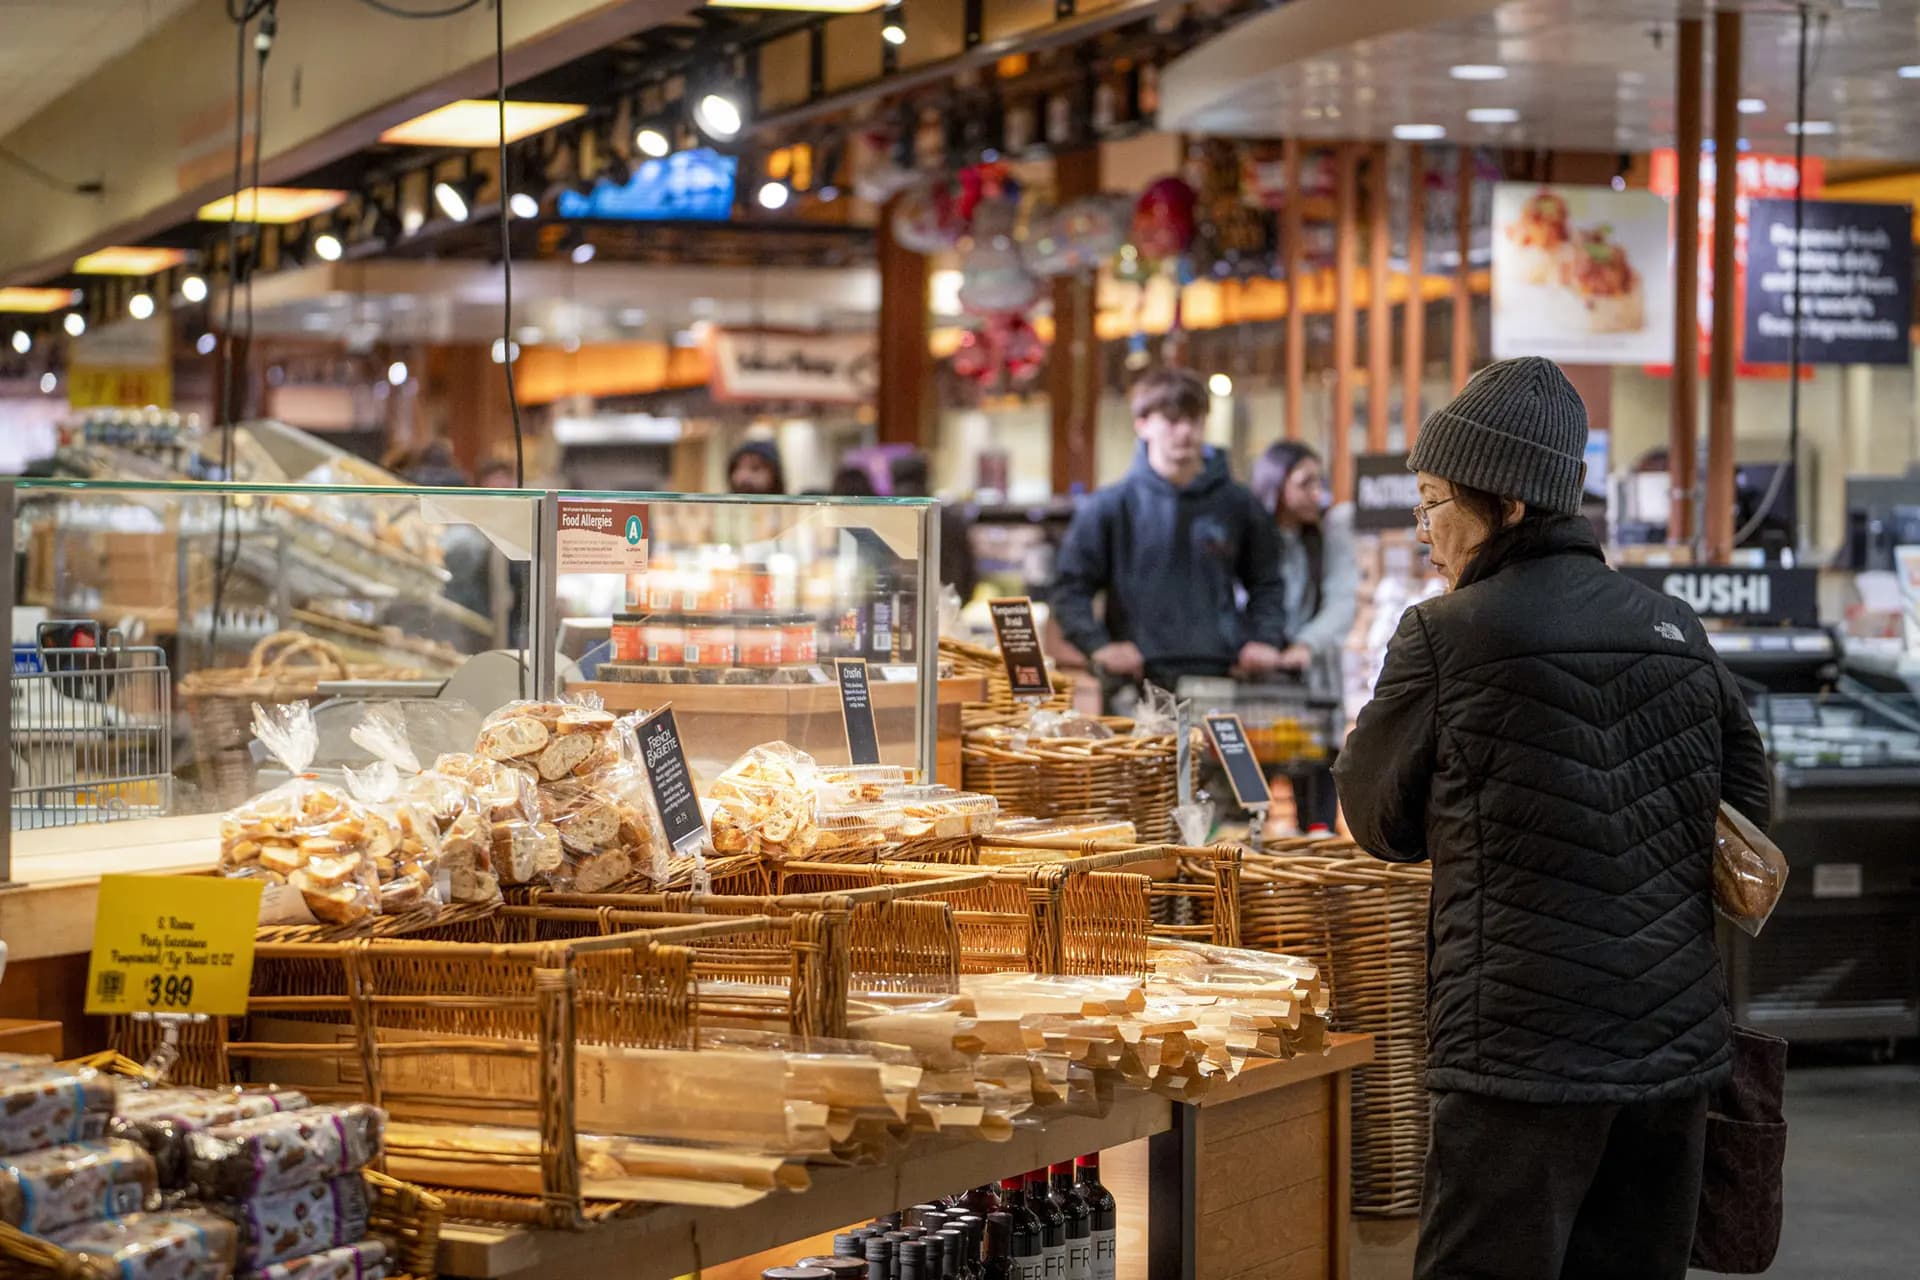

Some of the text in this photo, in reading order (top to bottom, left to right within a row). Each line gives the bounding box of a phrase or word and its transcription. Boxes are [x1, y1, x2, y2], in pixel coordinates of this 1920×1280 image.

[562, 513, 613, 529] Food Allergies
[628, 521, 639, 539] A
[1663, 573, 1771, 613] SUSHI
[648, 729, 671, 750] FRENCH
[647, 737, 678, 768] BAGUETTE
